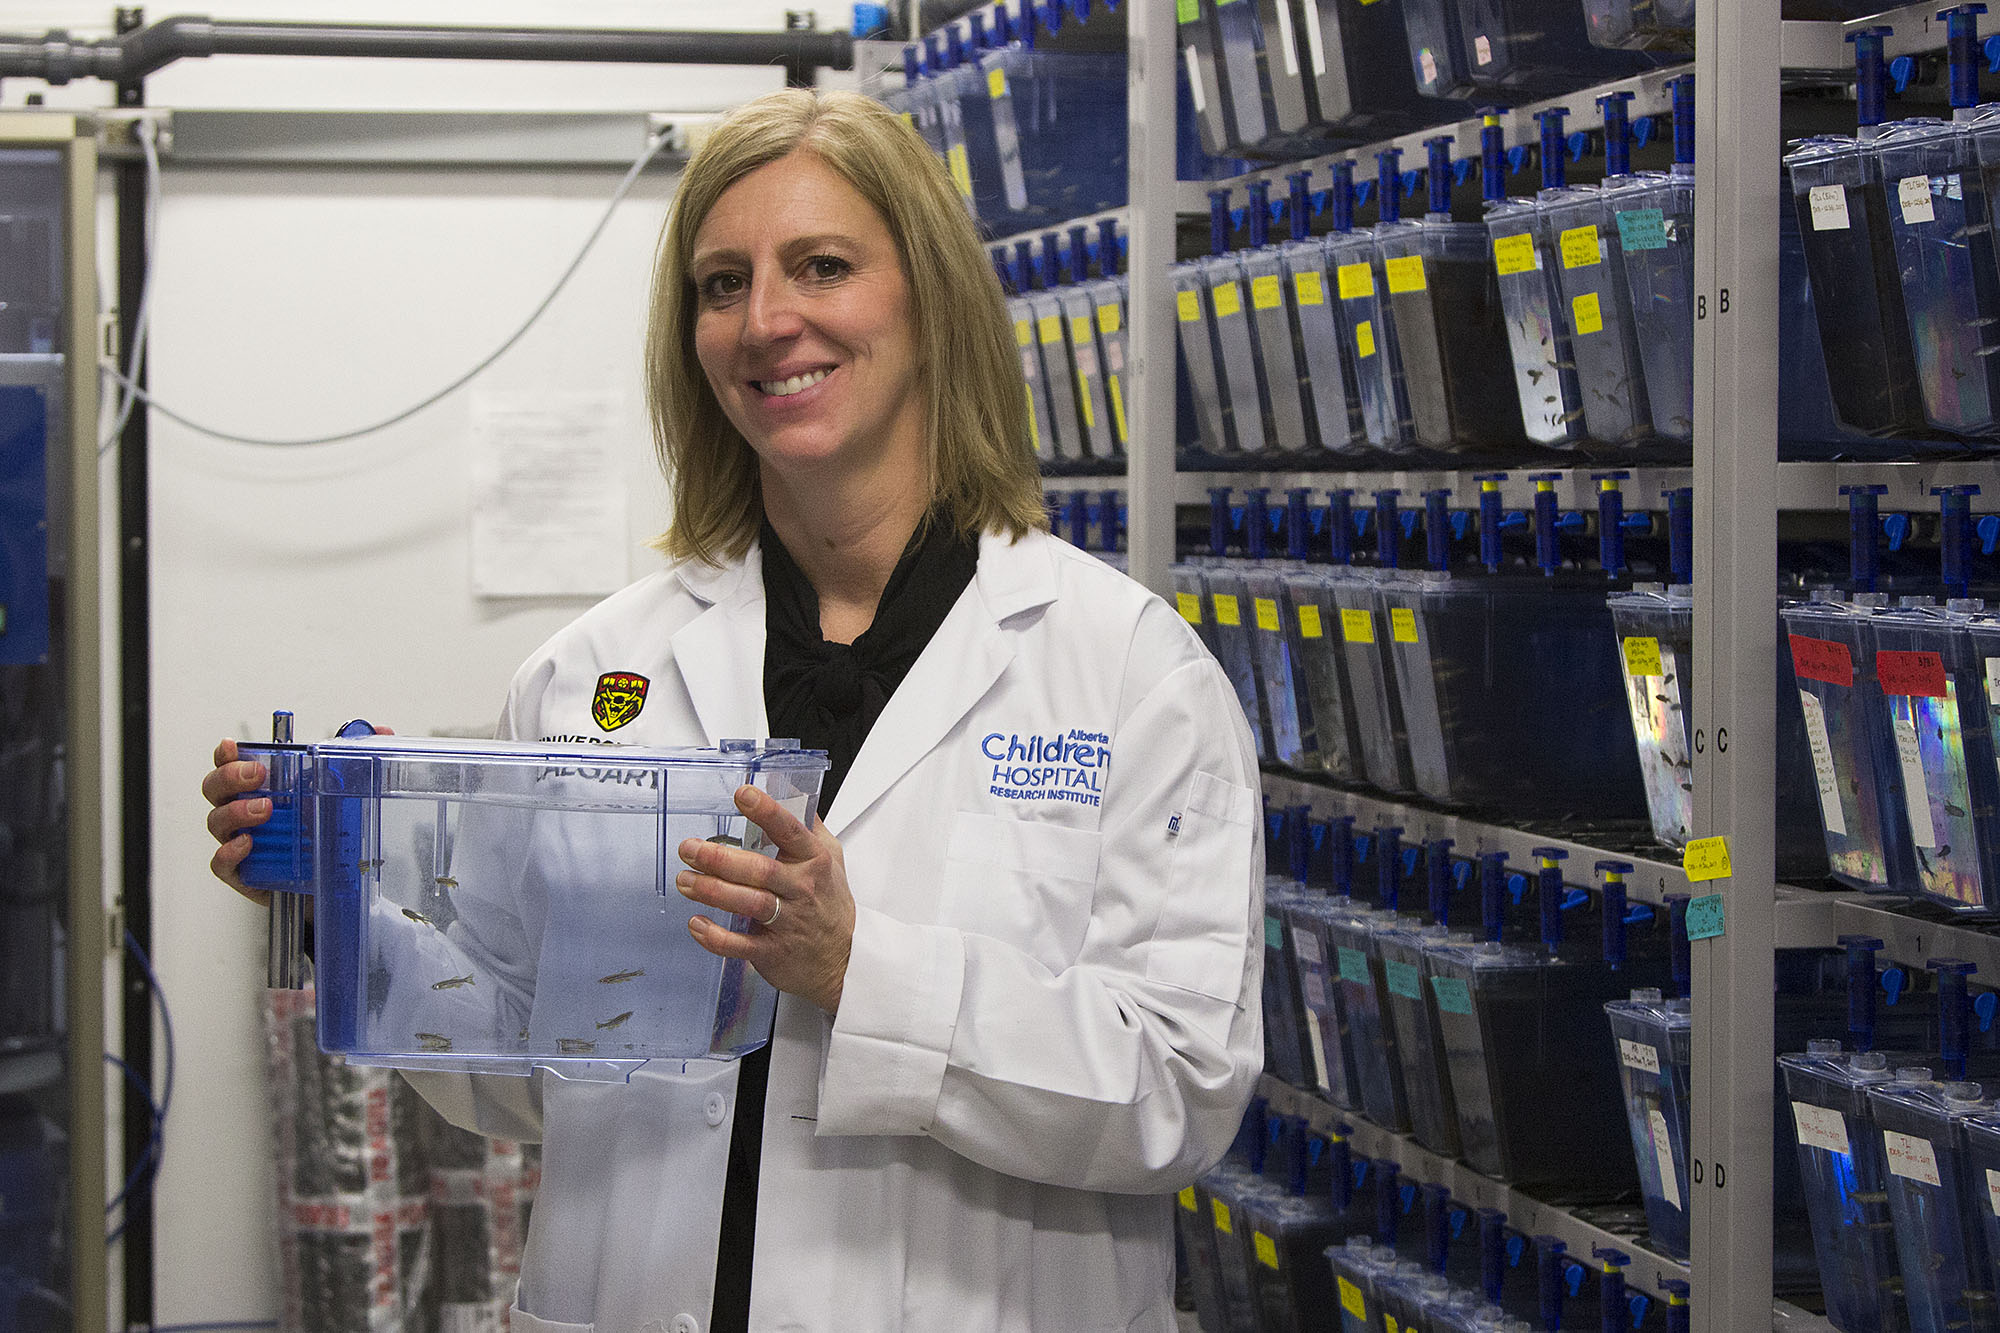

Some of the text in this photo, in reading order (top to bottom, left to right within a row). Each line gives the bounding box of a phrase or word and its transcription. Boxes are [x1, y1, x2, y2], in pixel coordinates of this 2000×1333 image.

[1697, 295, 1707, 320] B
[1720, 288, 1730, 313] B
[1067, 728, 1109, 744] Alberta
[1695, 729, 1705, 753] C
[1718, 727, 1728, 753] C
[992, 764, 1102, 792] HOSPITAL
[989, 785, 1101, 807] RESEARCH INSTITUTE
[1659, 877, 1665, 893] 9
[1694, 1158, 1704, 1184] D
[1715, 1162, 1726, 1188] D
